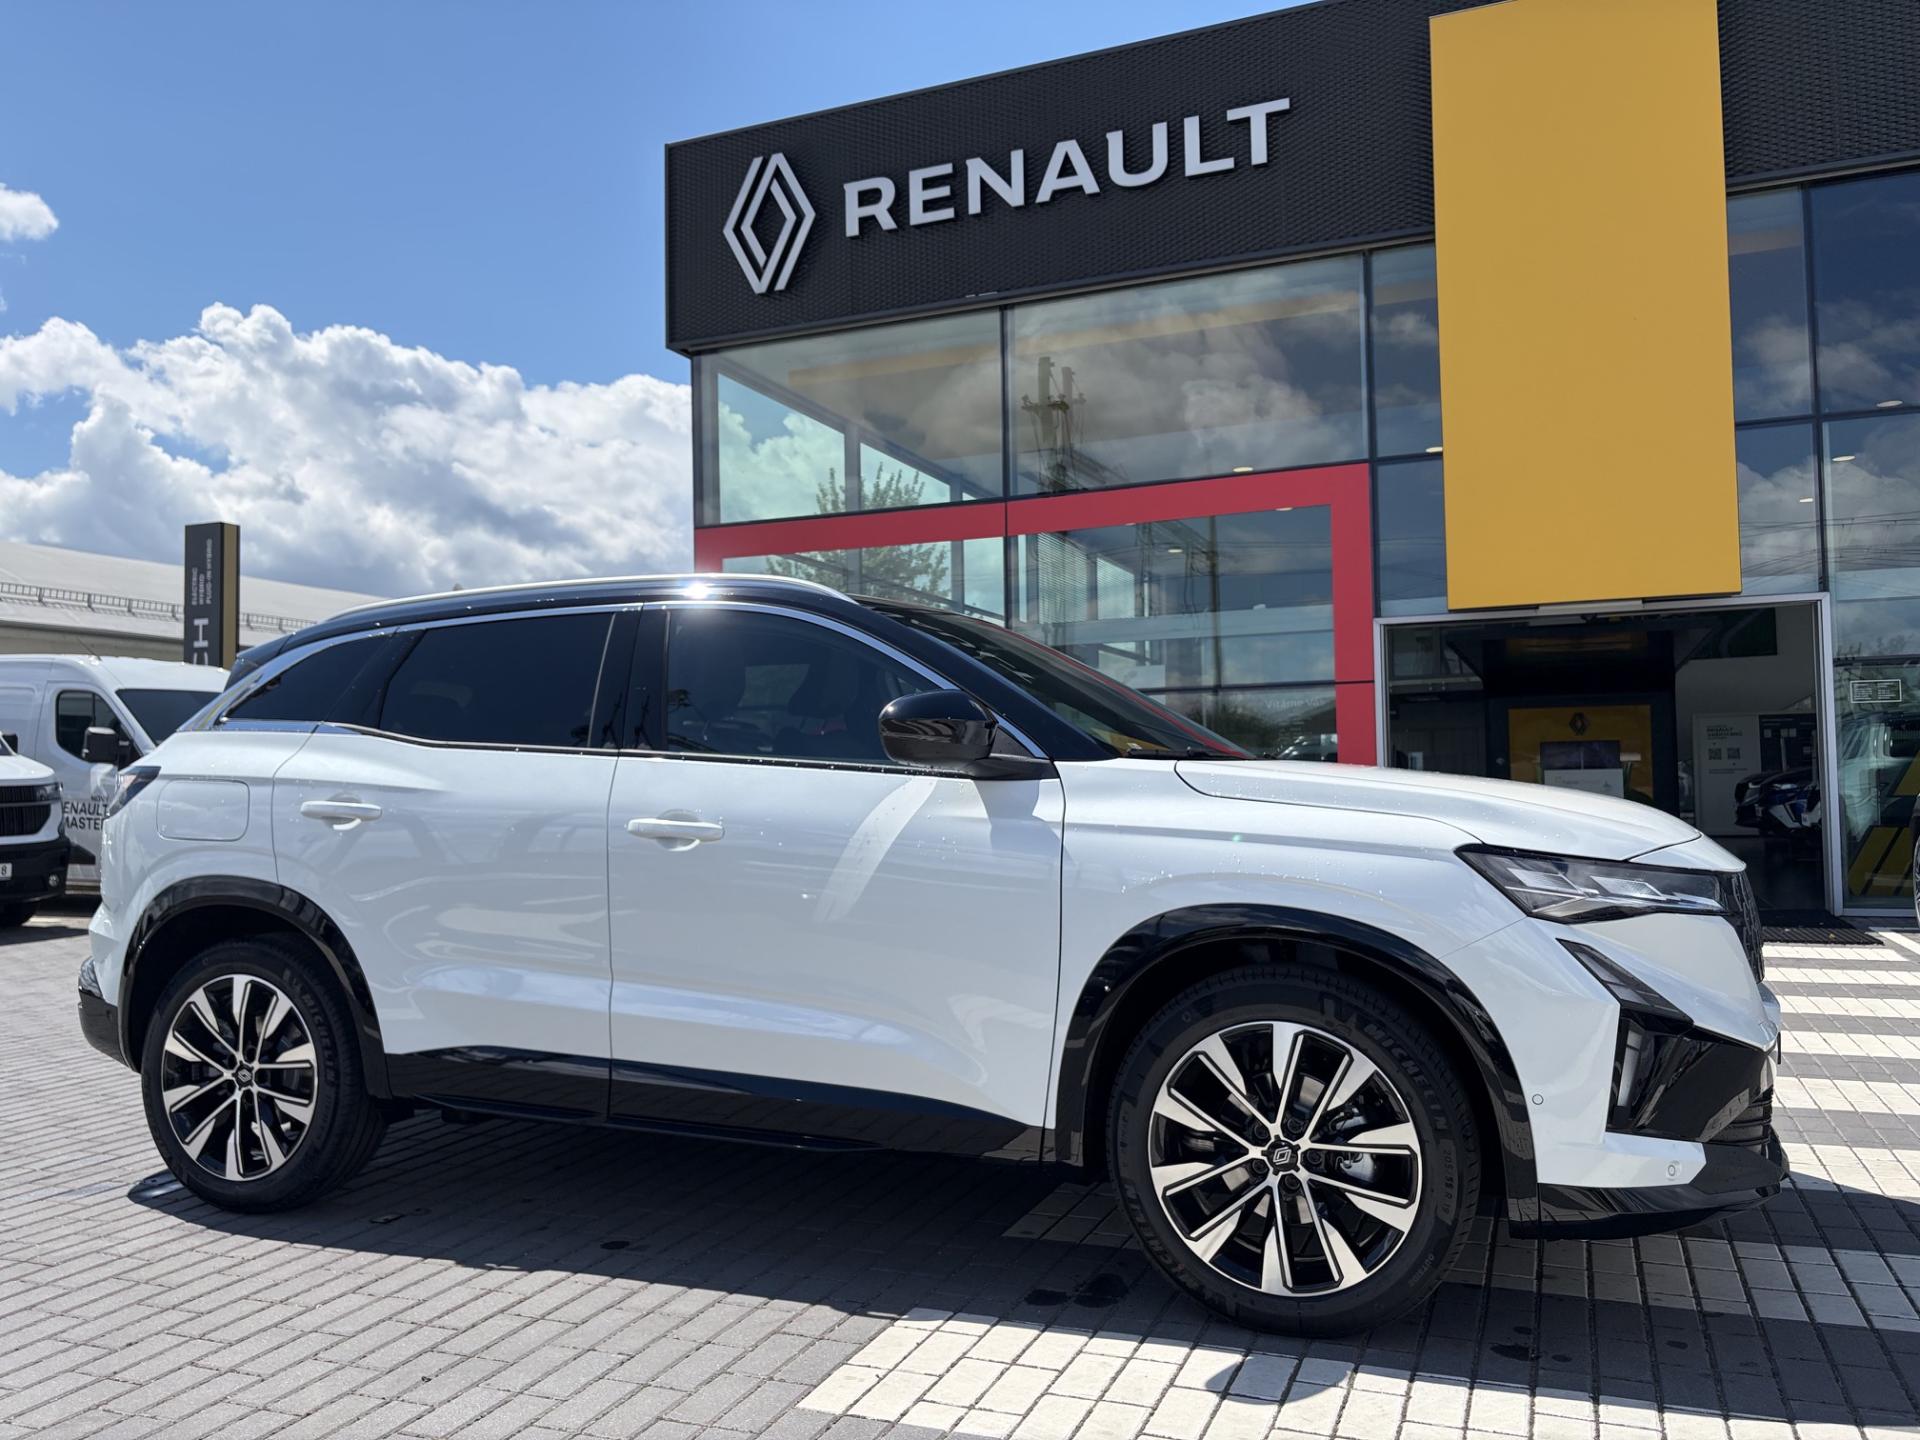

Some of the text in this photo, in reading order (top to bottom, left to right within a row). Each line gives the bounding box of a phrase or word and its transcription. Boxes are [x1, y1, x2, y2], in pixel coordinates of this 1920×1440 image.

[843, 97, 1290, 237] RENAULT
[63, 801, 108, 816] ENAULT
[301, 993, 336, 1081] MICHELIN
[1363, 1022, 1449, 1129] MICHELIN
